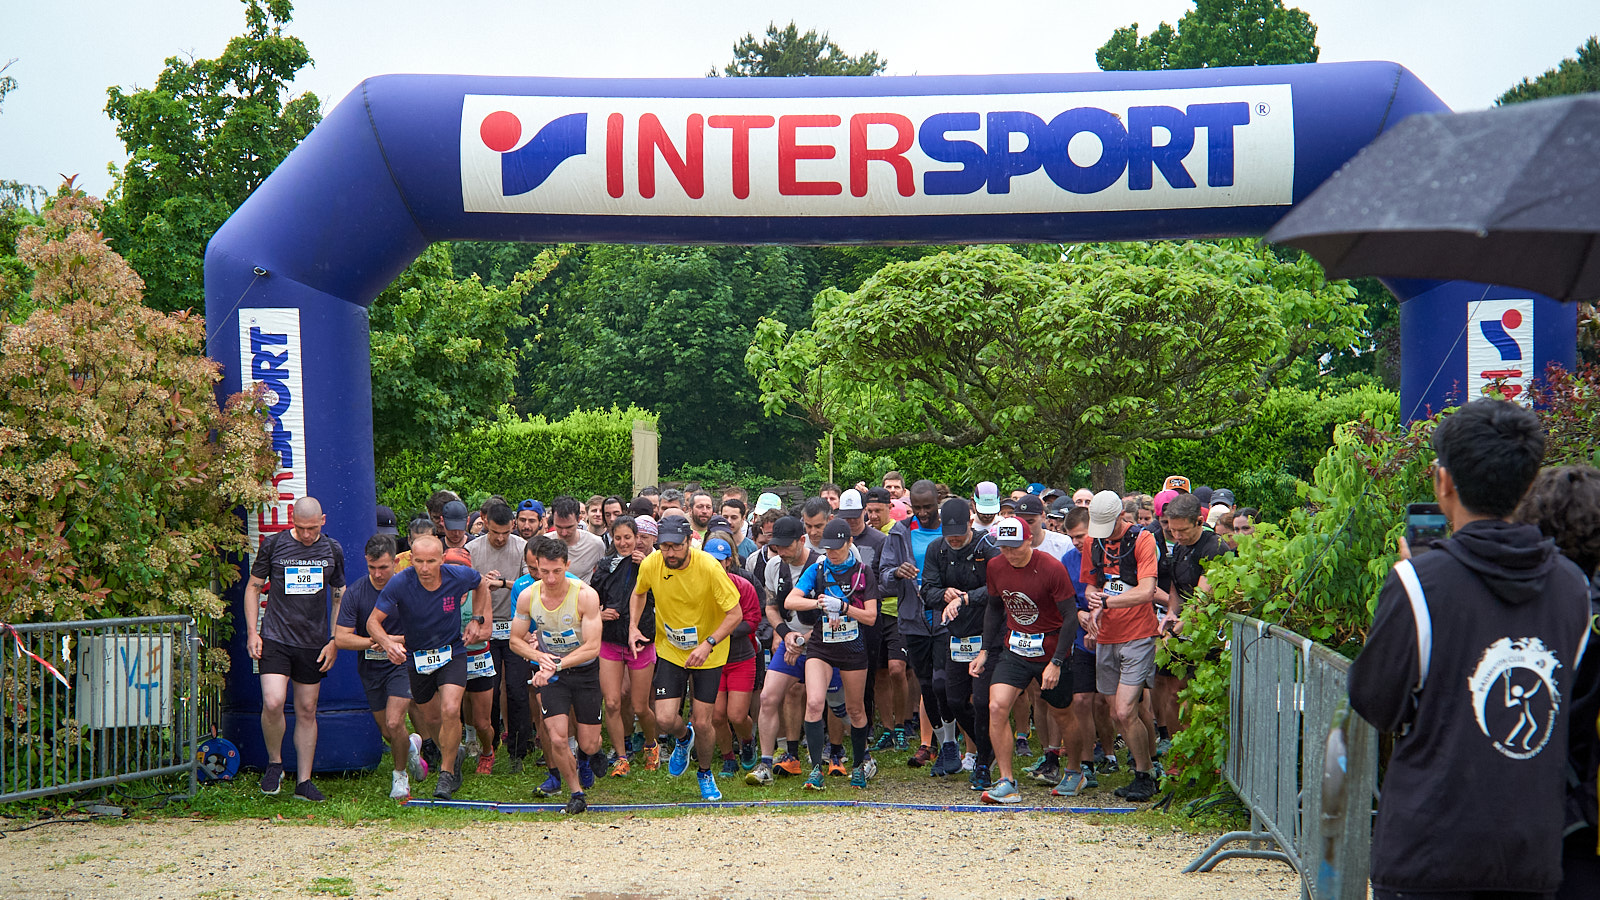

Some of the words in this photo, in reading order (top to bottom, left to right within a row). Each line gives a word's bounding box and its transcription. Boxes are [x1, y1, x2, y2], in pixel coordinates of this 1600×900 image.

[605, 101, 1250, 198] INTERSPORT
[297, 575, 311, 583] 528
[1110, 582, 1123, 592] 606
[427, 655, 440, 664] 674
[474, 661, 487, 670] 501
